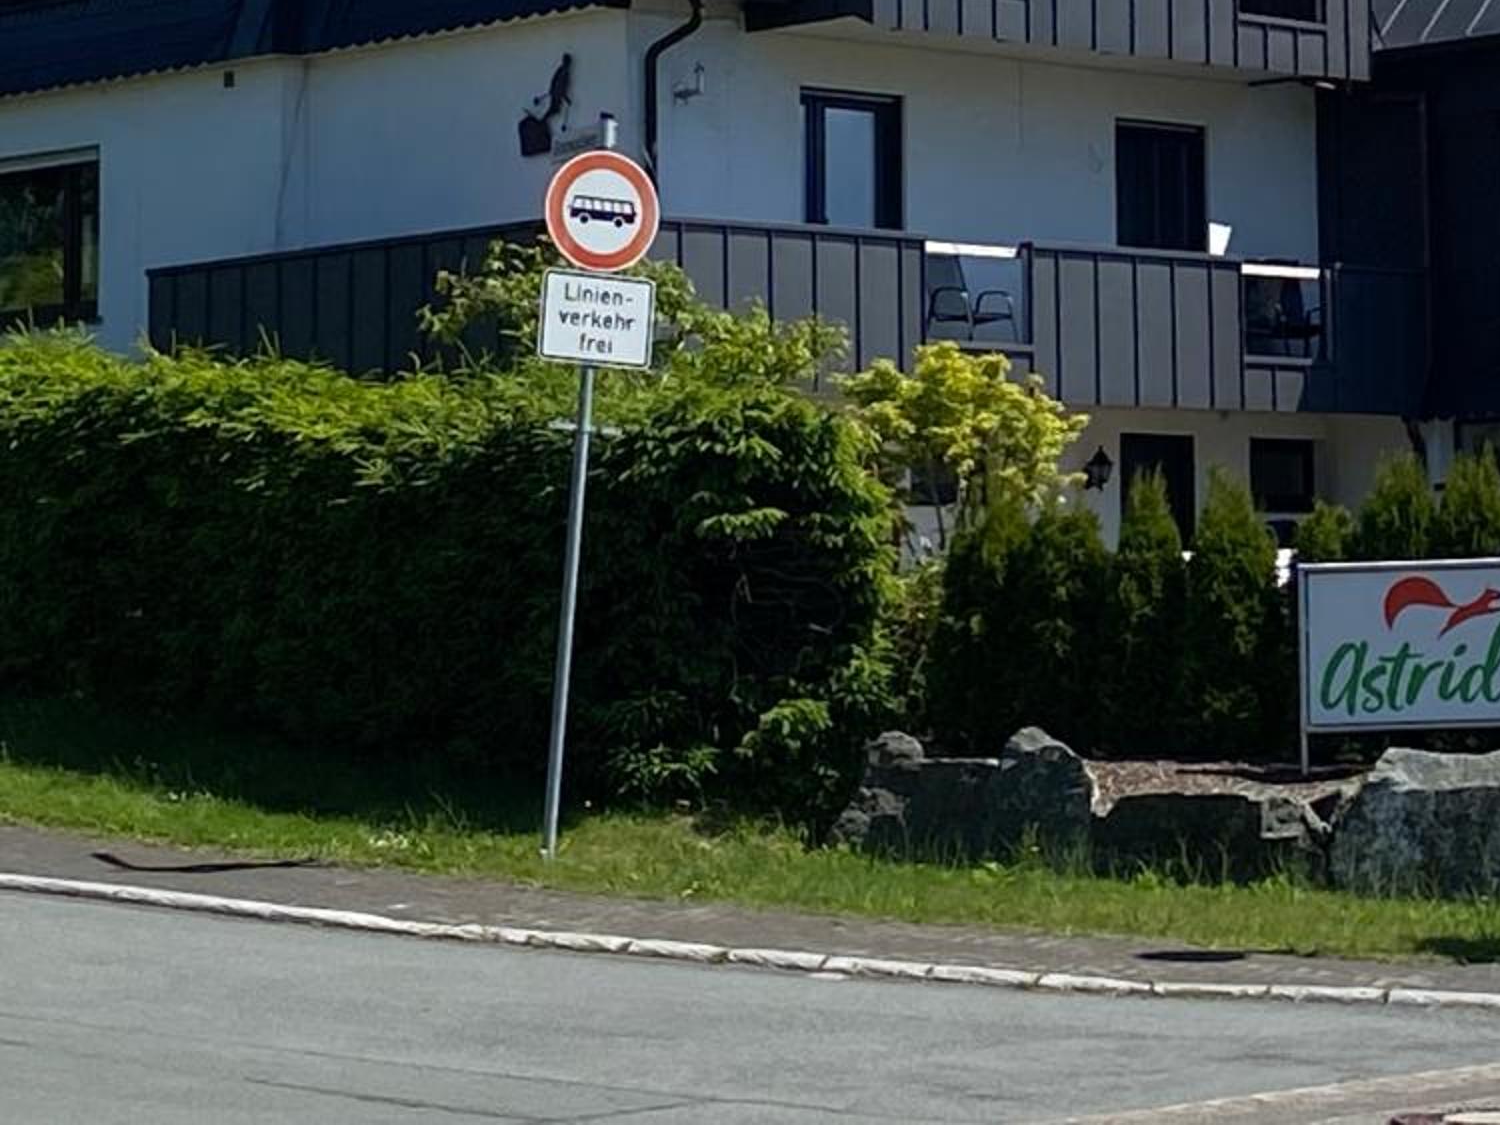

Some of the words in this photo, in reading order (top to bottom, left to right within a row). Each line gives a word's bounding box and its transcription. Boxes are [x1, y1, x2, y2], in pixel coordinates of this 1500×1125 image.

[564, 282, 633, 306] Linien-
[559, 310, 635, 331] verkehr
[580, 332, 613, 354] frei
